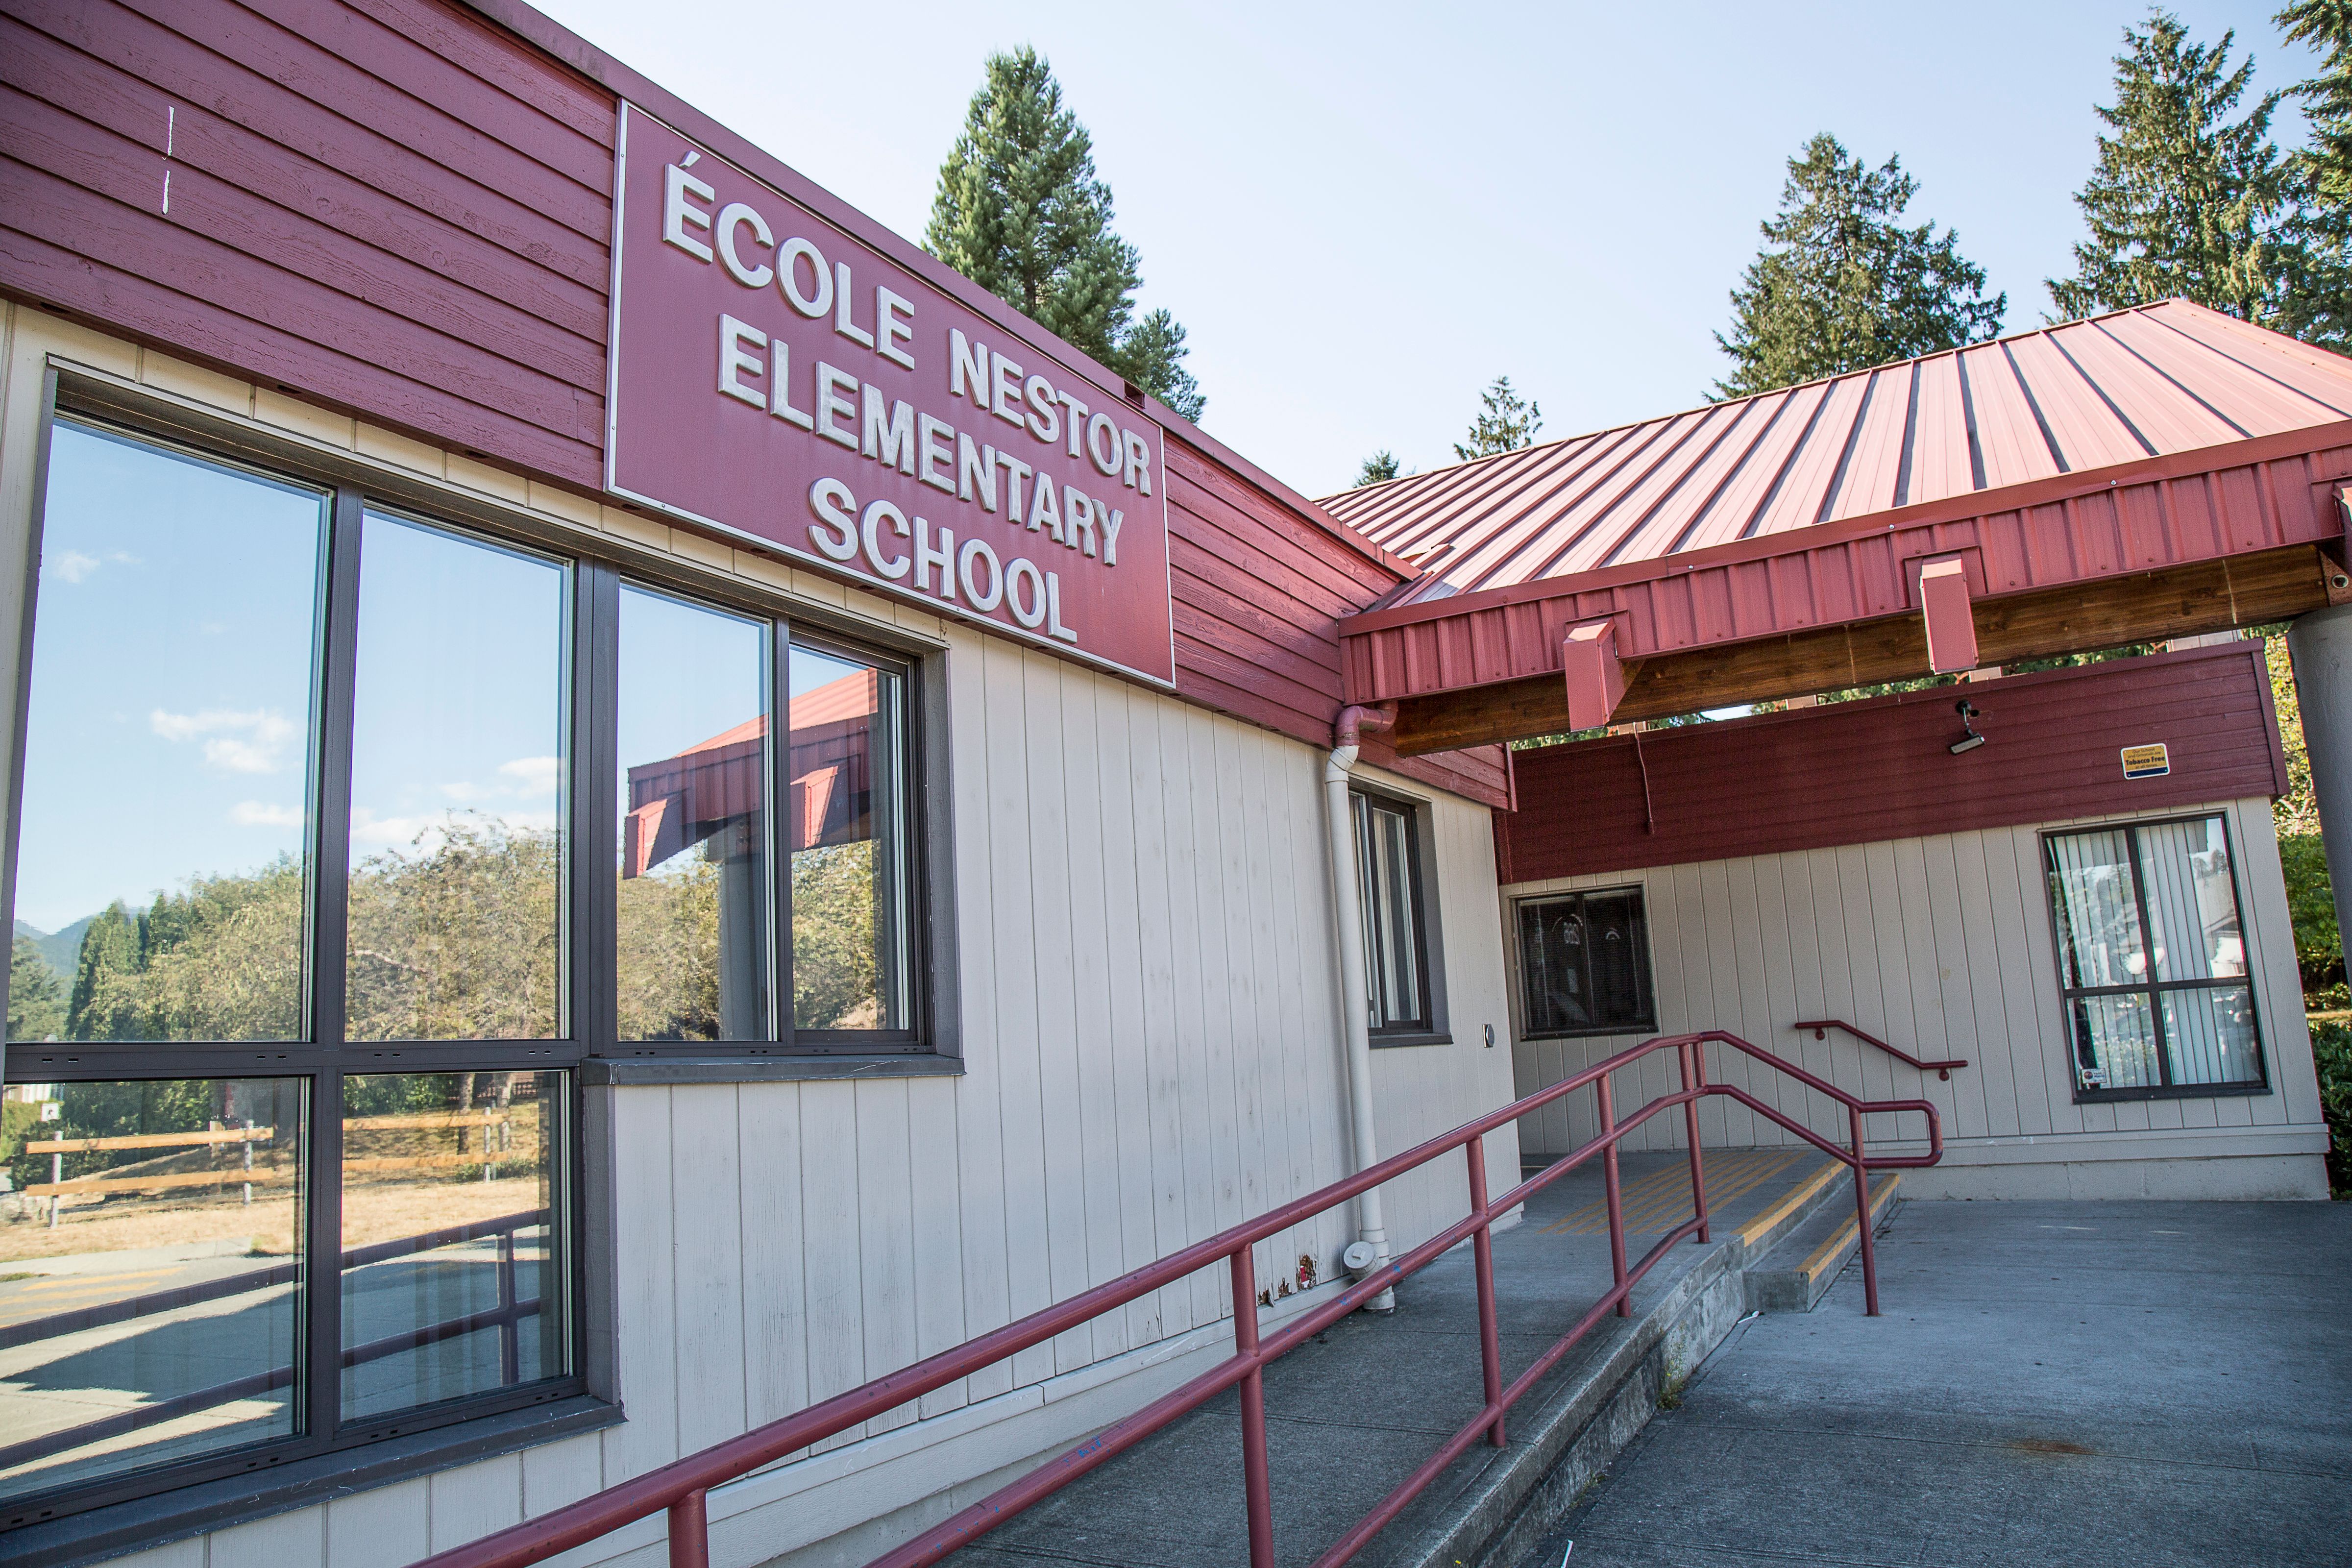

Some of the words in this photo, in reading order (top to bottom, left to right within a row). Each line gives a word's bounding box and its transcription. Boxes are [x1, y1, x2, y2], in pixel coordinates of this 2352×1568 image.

[663, 150, 915, 371] ÉCOLE
[950, 327, 1152, 497] NESTOR
[718, 313, 1124, 566] ELEMENTARY
[808, 477, 1078, 644] SCHOOL
